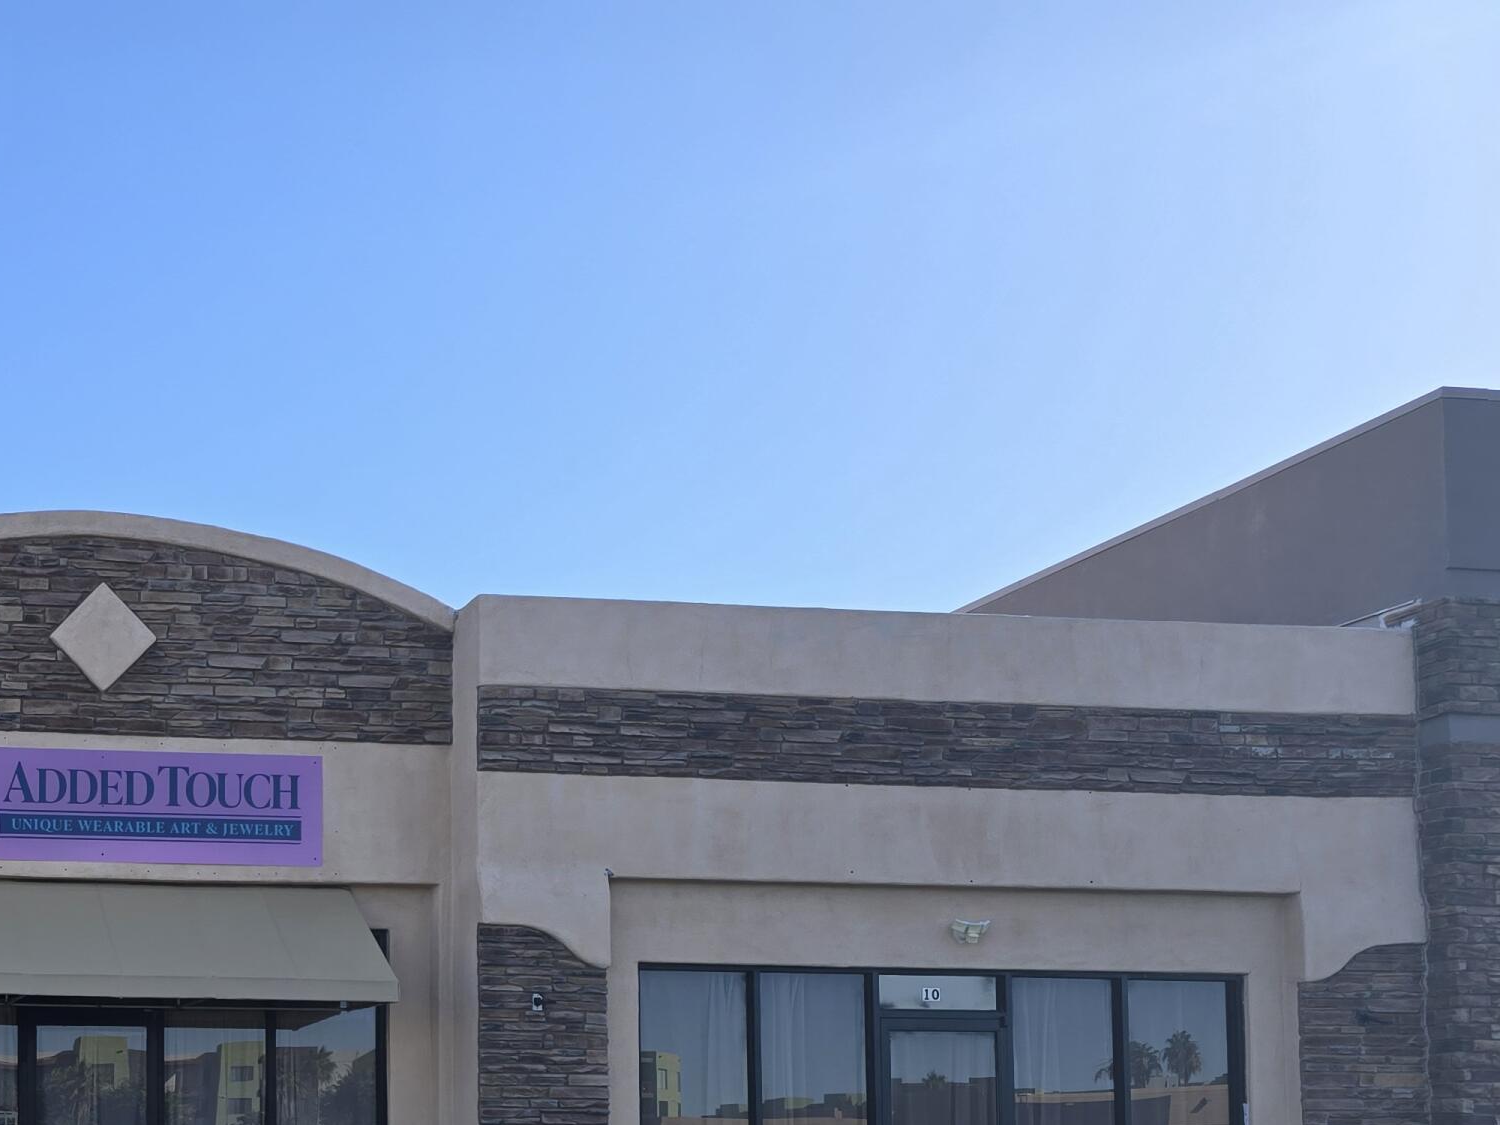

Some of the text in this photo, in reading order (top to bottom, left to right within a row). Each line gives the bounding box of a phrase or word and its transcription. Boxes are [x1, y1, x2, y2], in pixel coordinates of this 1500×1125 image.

[3, 761, 301, 810] ADDED TOUCH
[11, 816, 294, 838] UNIQUE WEARABLE ART & JEWELRY
[924, 988, 940, 1001] 10
